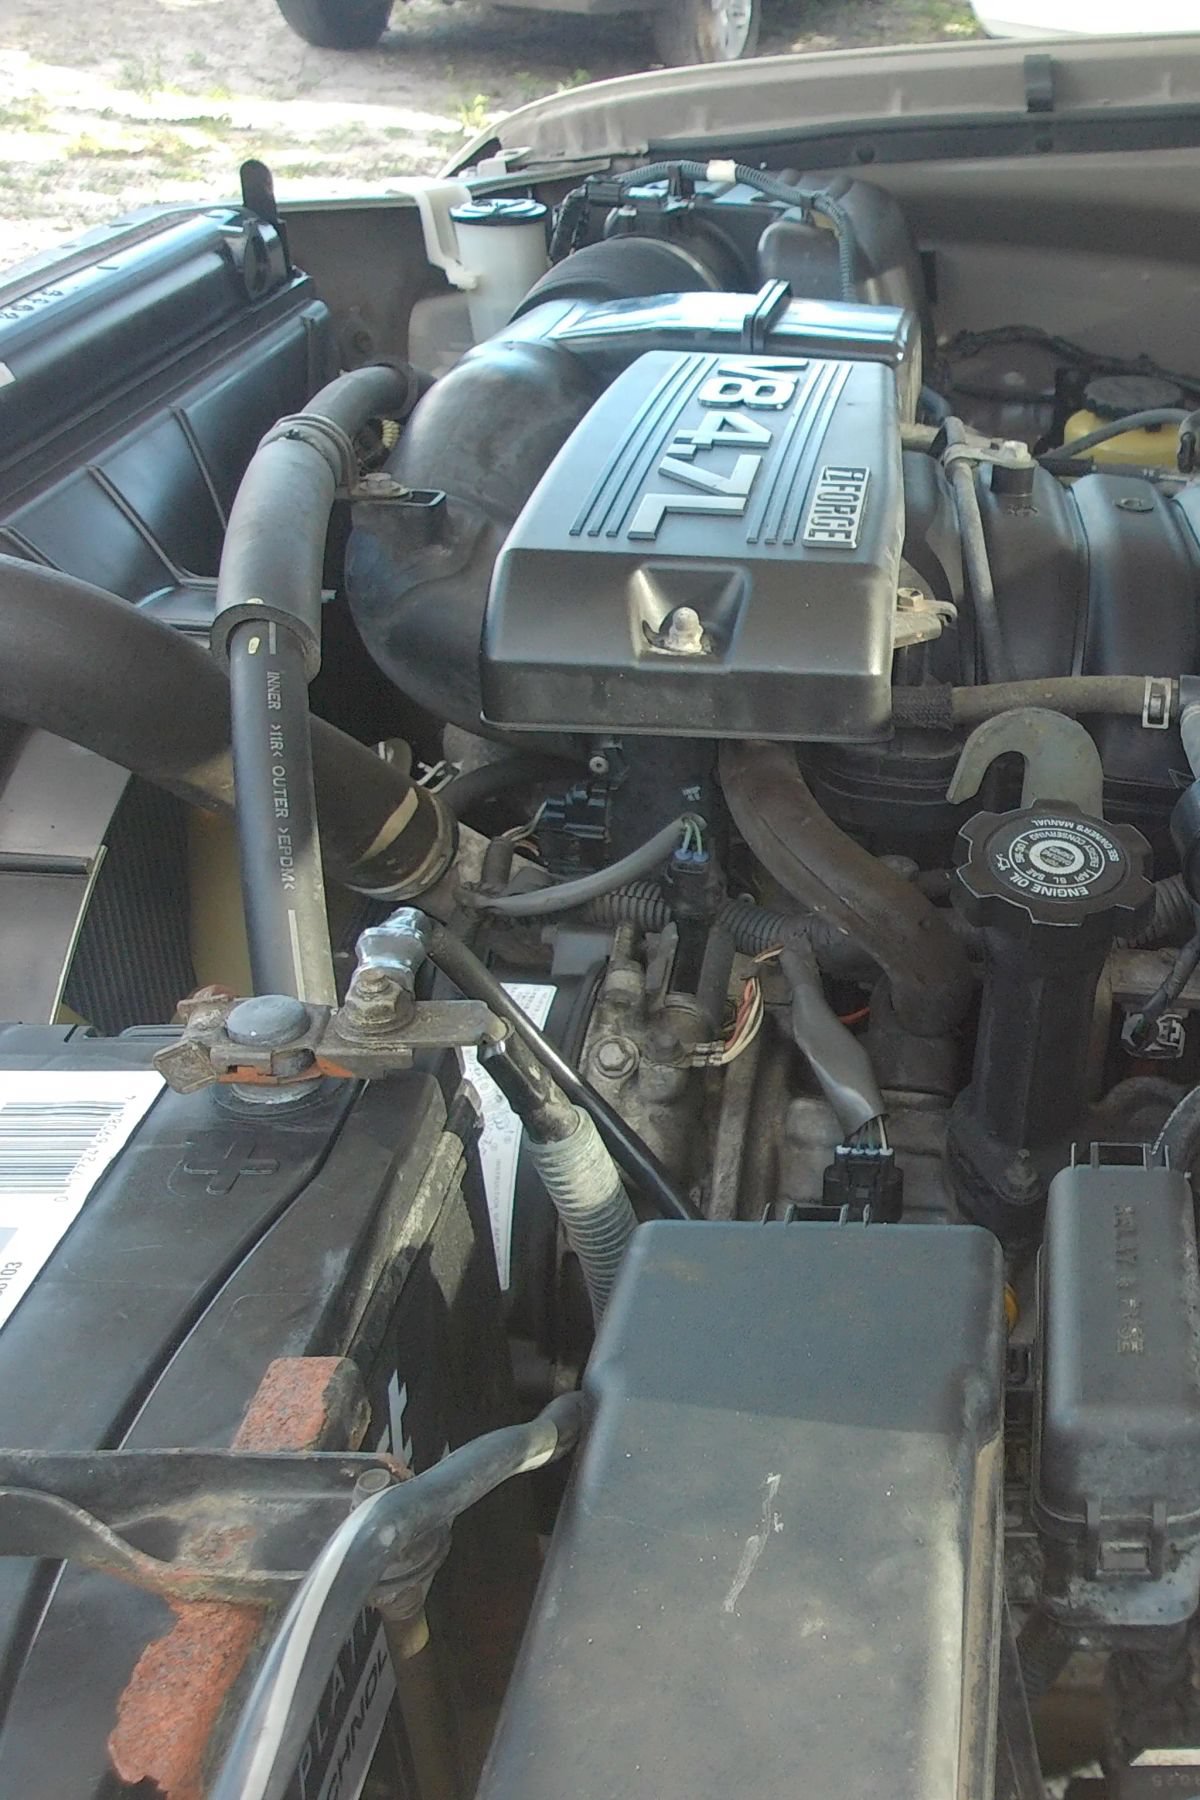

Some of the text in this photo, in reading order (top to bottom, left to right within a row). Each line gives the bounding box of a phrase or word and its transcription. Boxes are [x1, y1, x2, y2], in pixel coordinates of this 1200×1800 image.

[266, 671, 282, 710] INNER
[272, 765, 289, 819] OUTER
[1031, 818, 1074, 829] MANUAL
[1029, 831, 1086, 845] CONSERVING
[1109, 848, 1120, 862] SEE
[1025, 867, 1046, 881] SAE
[1052, 876, 1067, 885] SL
[1074, 869, 1089, 882] API
[1008, 871, 1089, 898] ENGINE OIL
